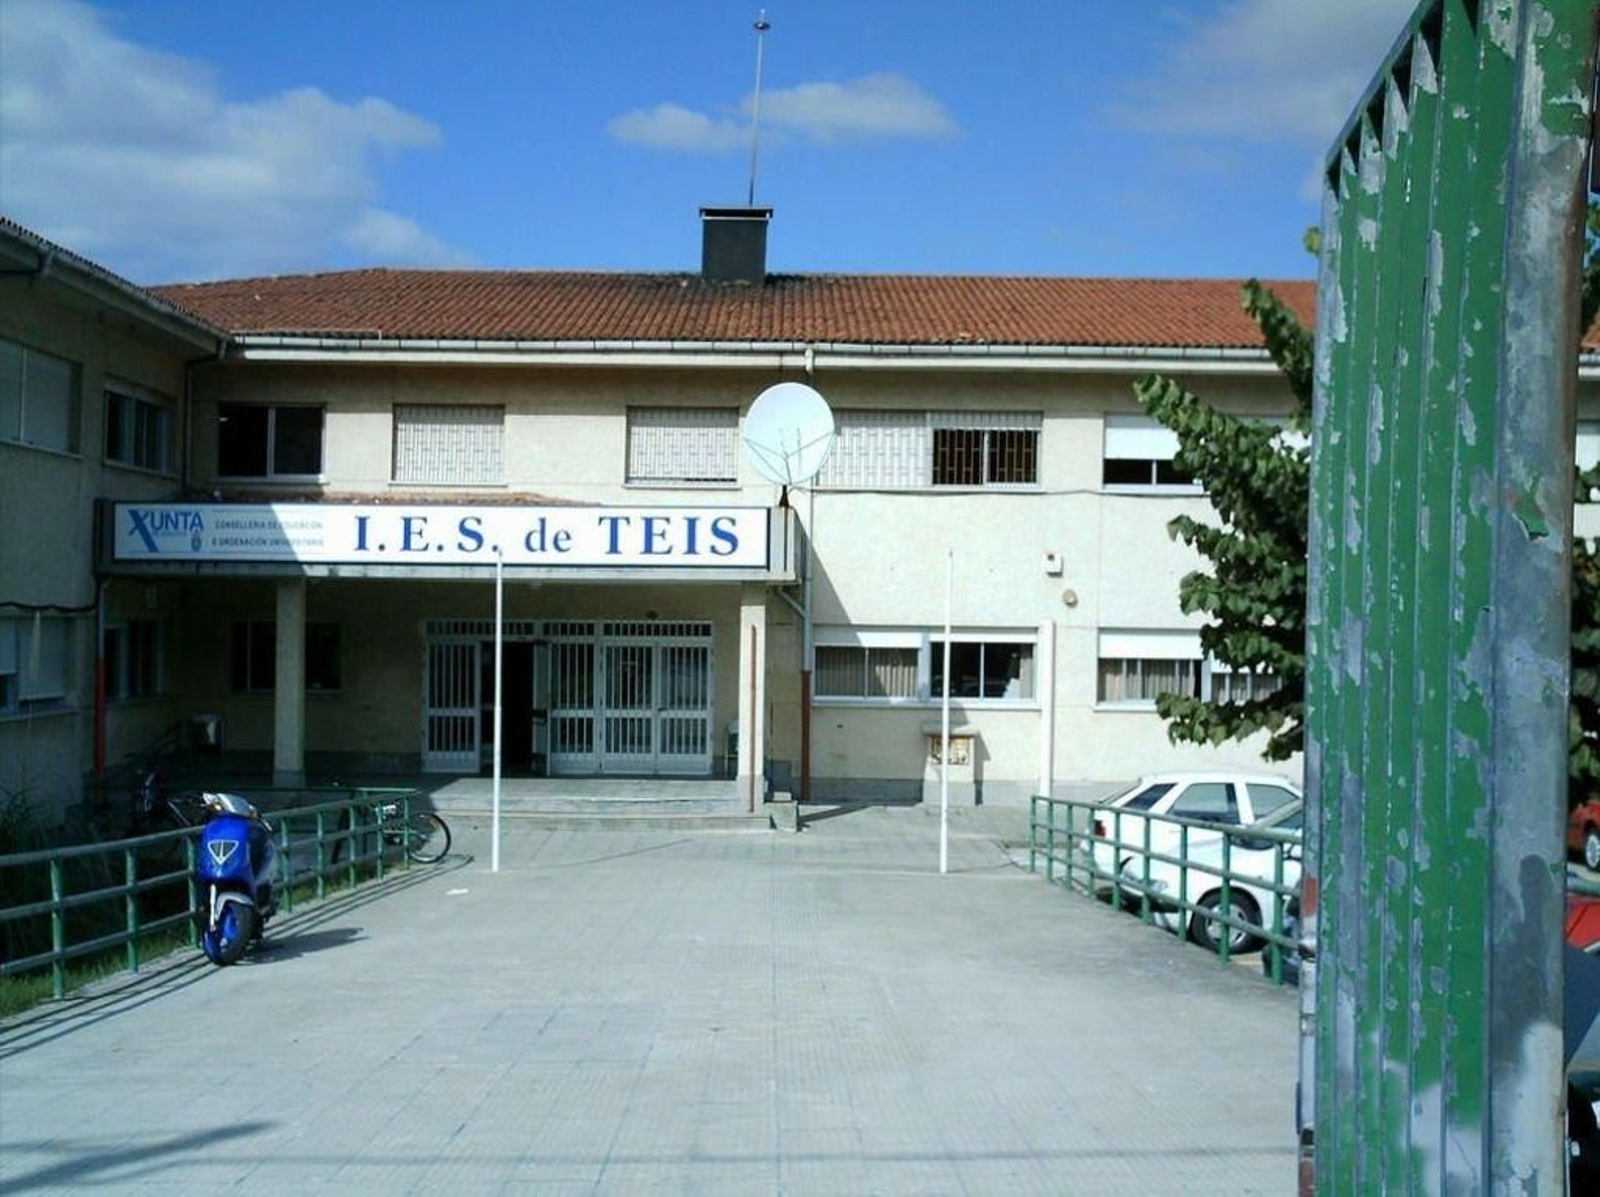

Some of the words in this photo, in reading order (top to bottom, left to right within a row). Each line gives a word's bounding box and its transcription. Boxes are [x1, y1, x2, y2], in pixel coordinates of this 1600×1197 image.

[127, 509, 204, 552] XUNTA
[353, 515, 500, 552] I.E.S.
[524, 517, 572, 552] de
[599, 516, 740, 556] TEIS
